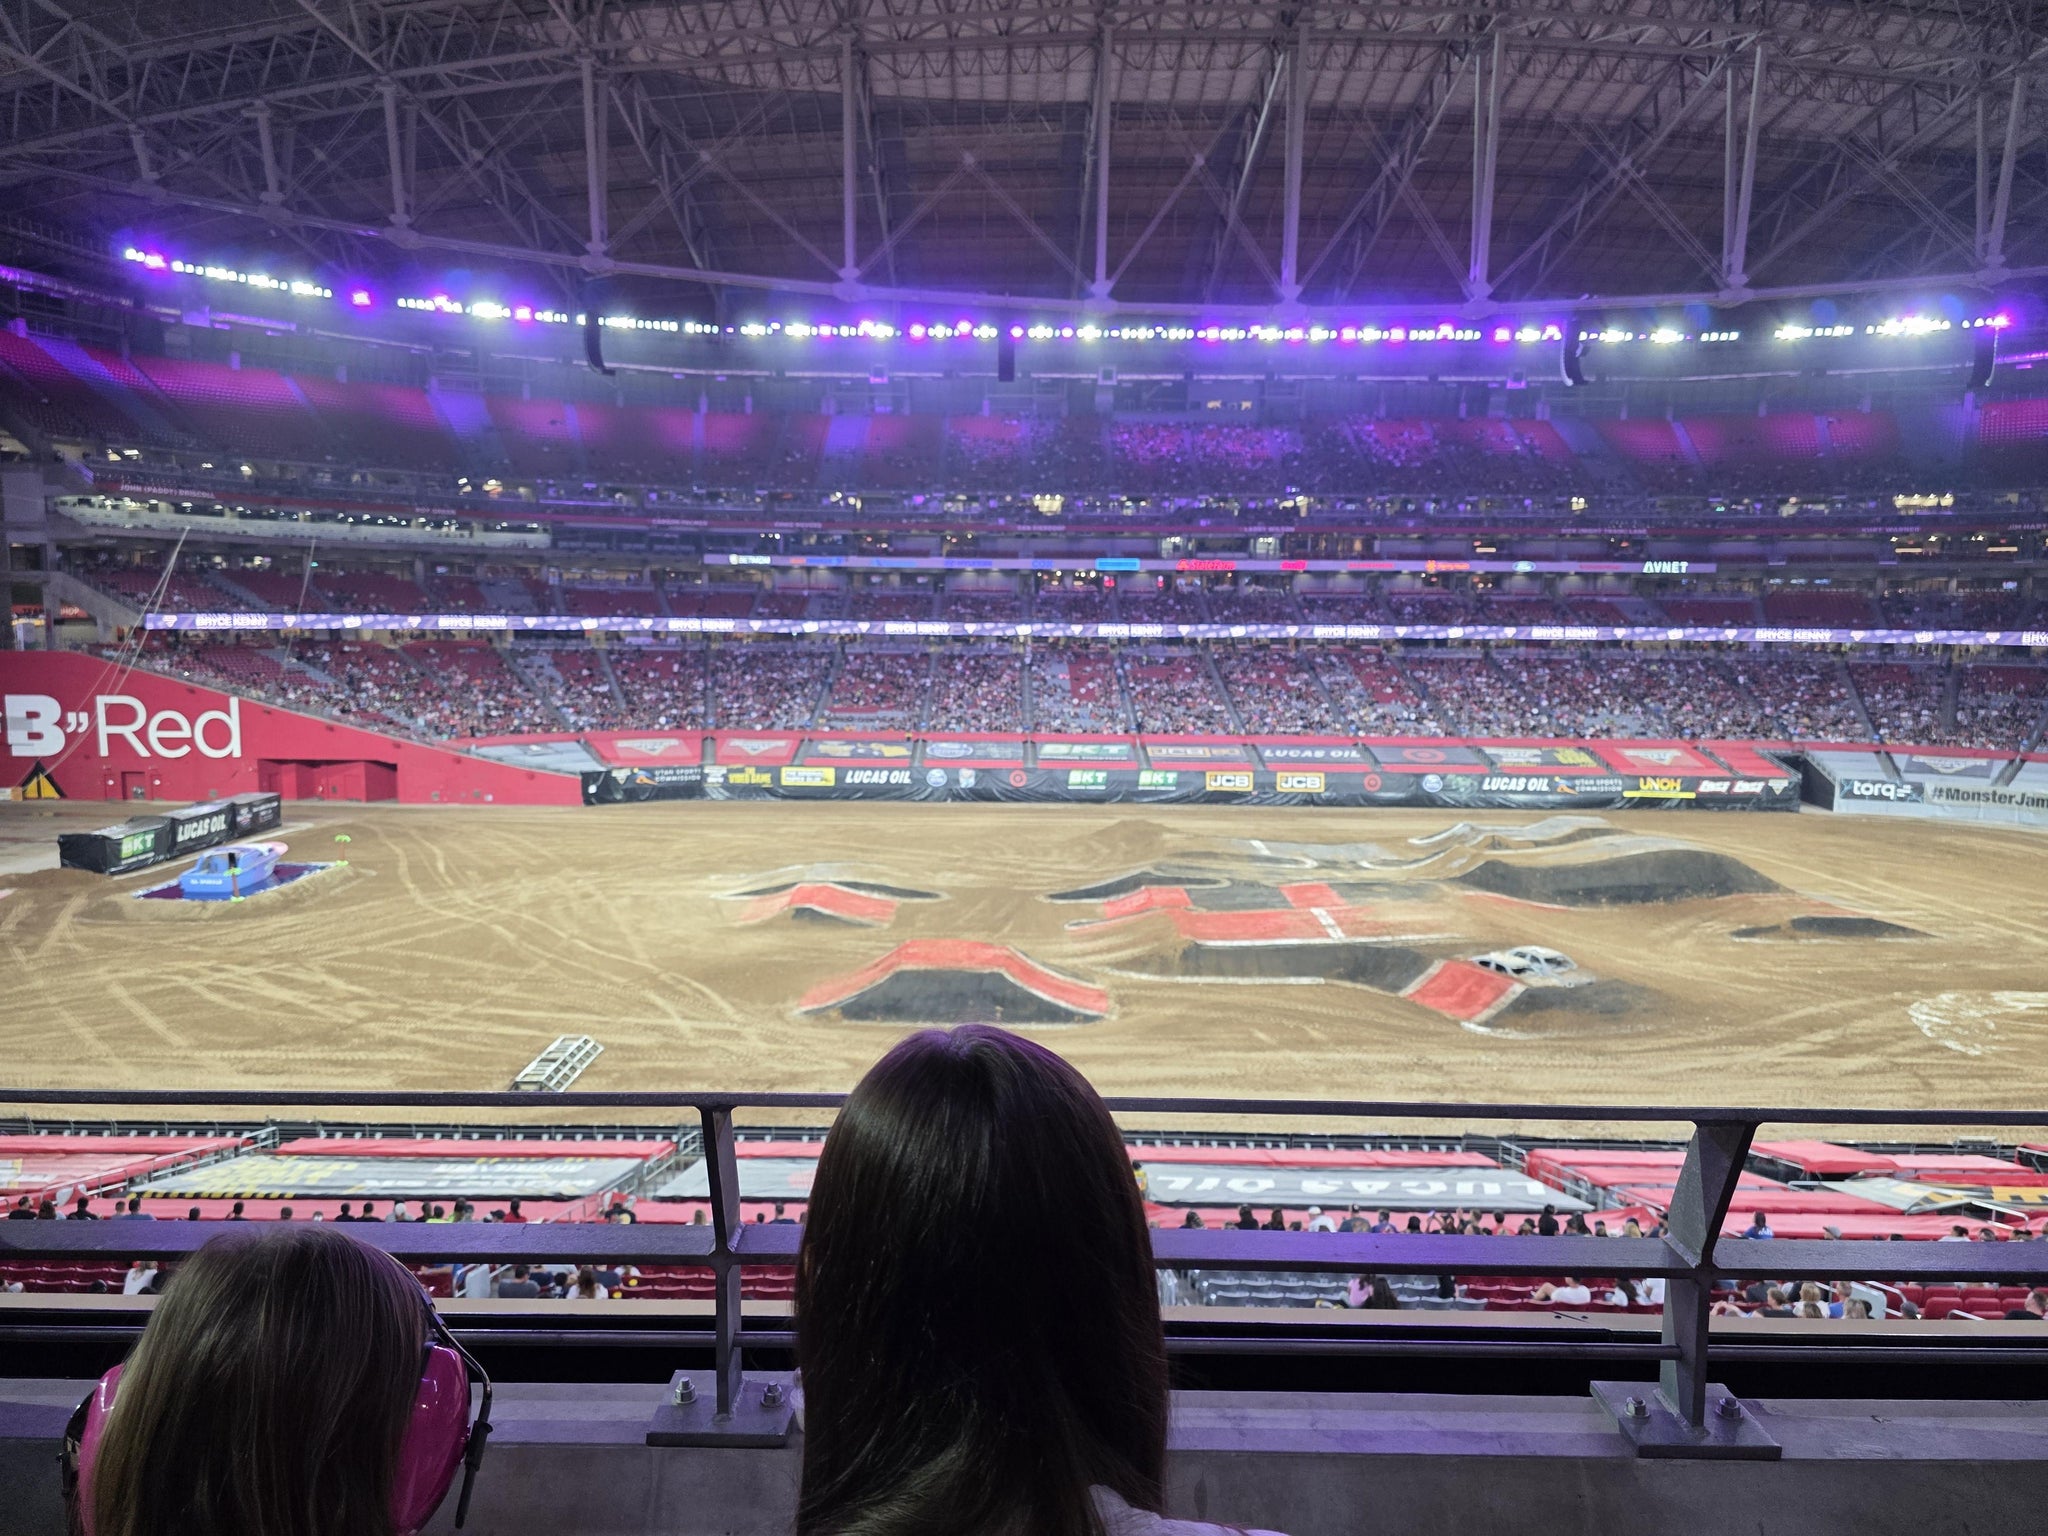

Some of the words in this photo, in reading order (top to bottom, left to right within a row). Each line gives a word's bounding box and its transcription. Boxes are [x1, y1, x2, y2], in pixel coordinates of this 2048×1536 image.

[1642, 561, 1689, 574] AVNET
[195, 614, 232, 629] BRYCE
[232, 614, 268, 629] KENNY
[438, 616, 472, 629] BRYCE
[473, 616, 507, 630] KENNY
[1531, 626, 1564, 639] BRYCE
[1564, 626, 1598, 640] KENNY
[1755, 628, 1792, 642] BRYCE
[1793, 629, 1832, 642] KENNY
[0, 695, 89, 757] B”
[96, 695, 242, 758] Red
[1264, 749, 1325, 758] LUCAS
[1330, 750, 1361, 759] OIL
[845, 770, 889, 784] LUCAS
[889, 770, 912, 784] OIL
[1210, 775, 1249, 788] JCB
[1280, 776, 1321, 789] JCB
[1639, 777, 1682, 791] UNOH
[1482, 777, 1527, 792] LUCAS
[1527, 777, 1550, 792] OIL
[177, 819, 210, 843] LUCAS
[210, 814, 226, 832] OIL
[1156, 1176, 1275, 1194] OIL
[1300, 1179, 1547, 1196] LUCAS
